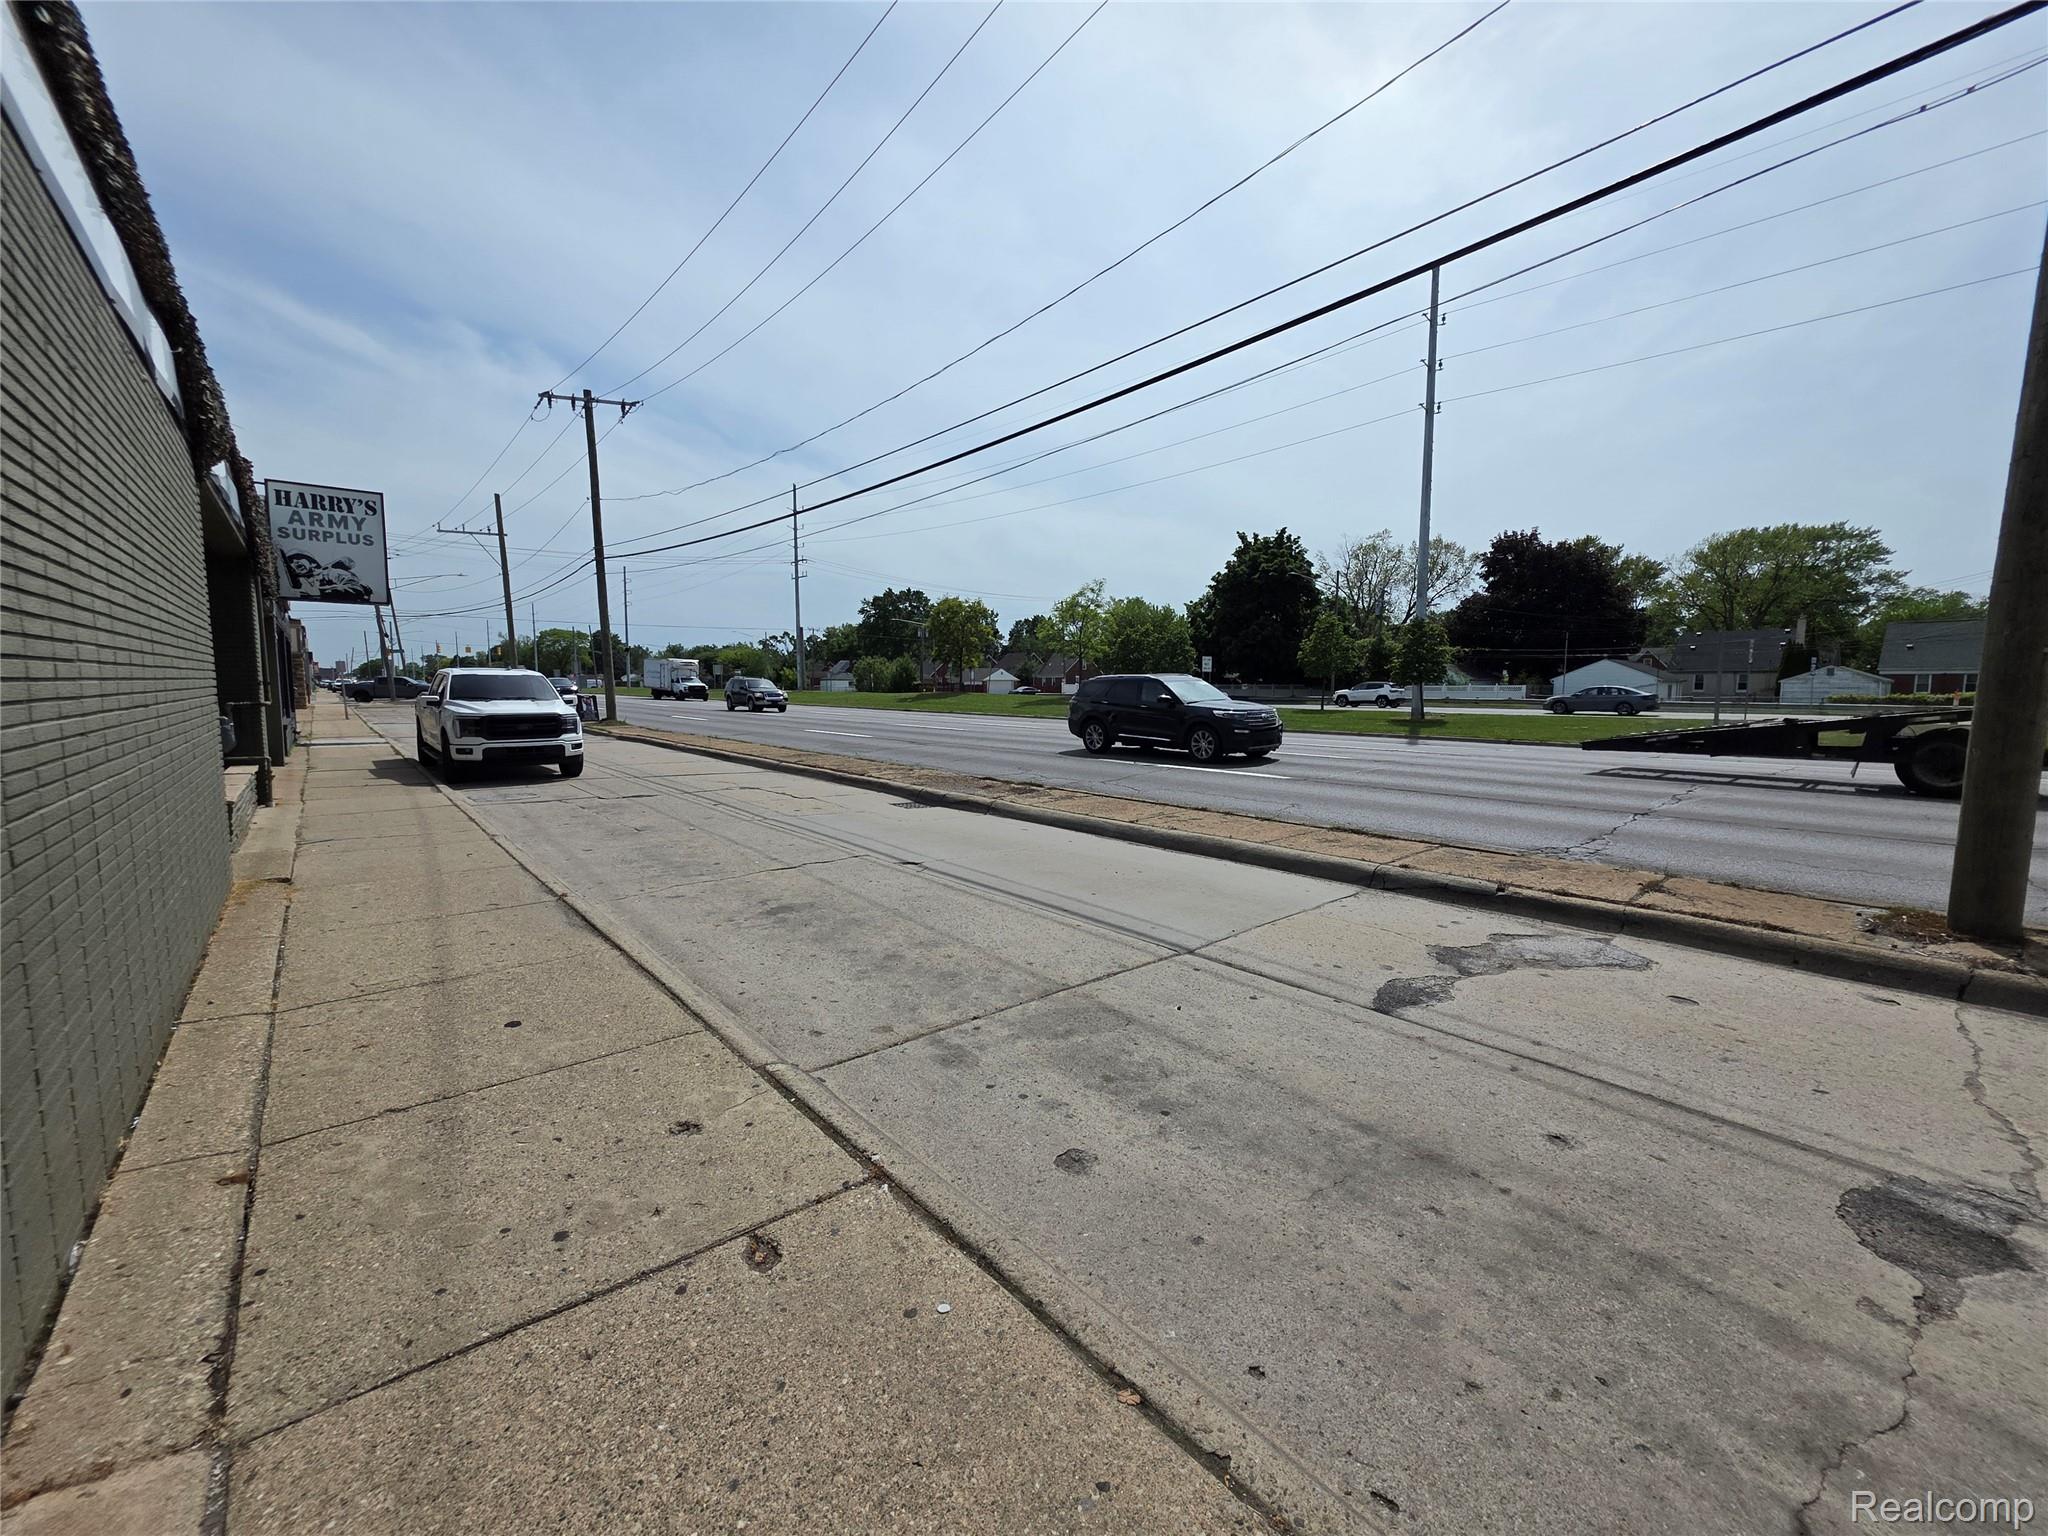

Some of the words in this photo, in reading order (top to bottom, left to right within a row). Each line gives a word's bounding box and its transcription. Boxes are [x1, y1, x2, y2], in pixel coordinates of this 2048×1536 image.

[273, 488, 377, 516] HARRY'S
[288, 510, 367, 531] ARMY
[277, 526, 374, 546] SURPLUS
